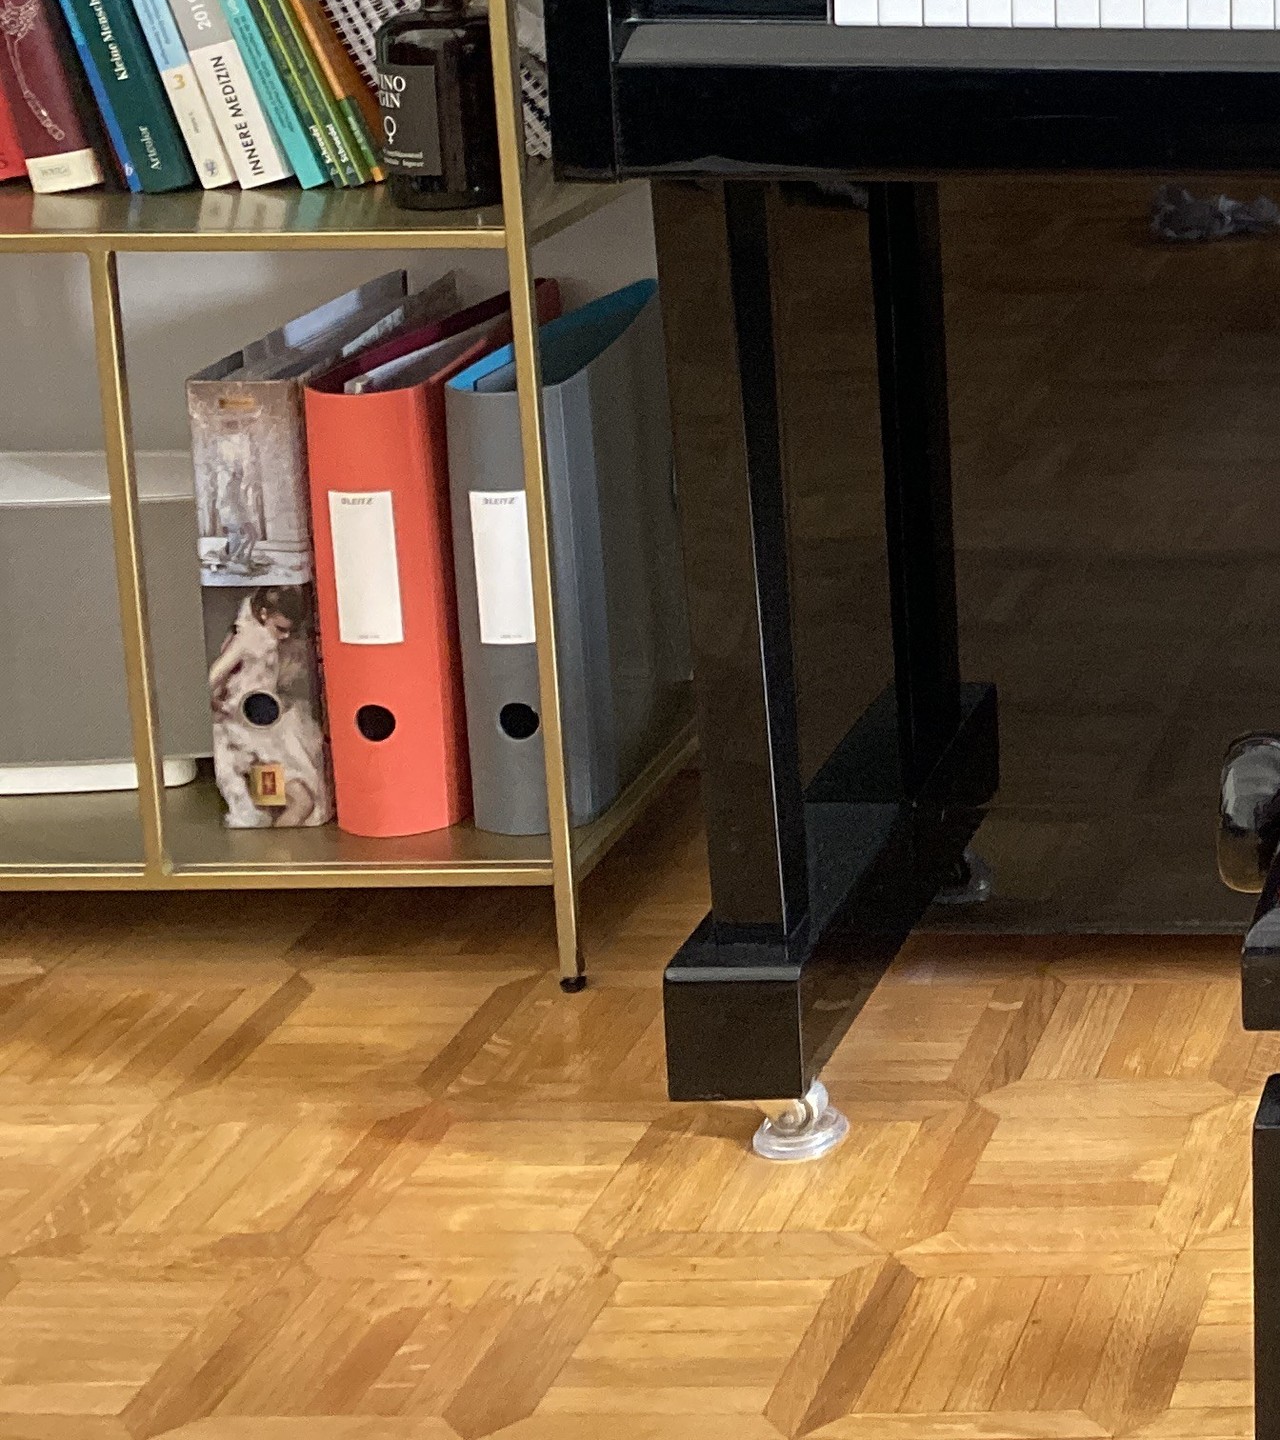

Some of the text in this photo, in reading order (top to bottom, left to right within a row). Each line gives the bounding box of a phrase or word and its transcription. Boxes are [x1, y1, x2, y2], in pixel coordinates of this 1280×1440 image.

[108, 43, 129, 81] Kleine
[210, 55, 244, 118] MEDIZIN
[235, 121, 265, 176] INNERE
